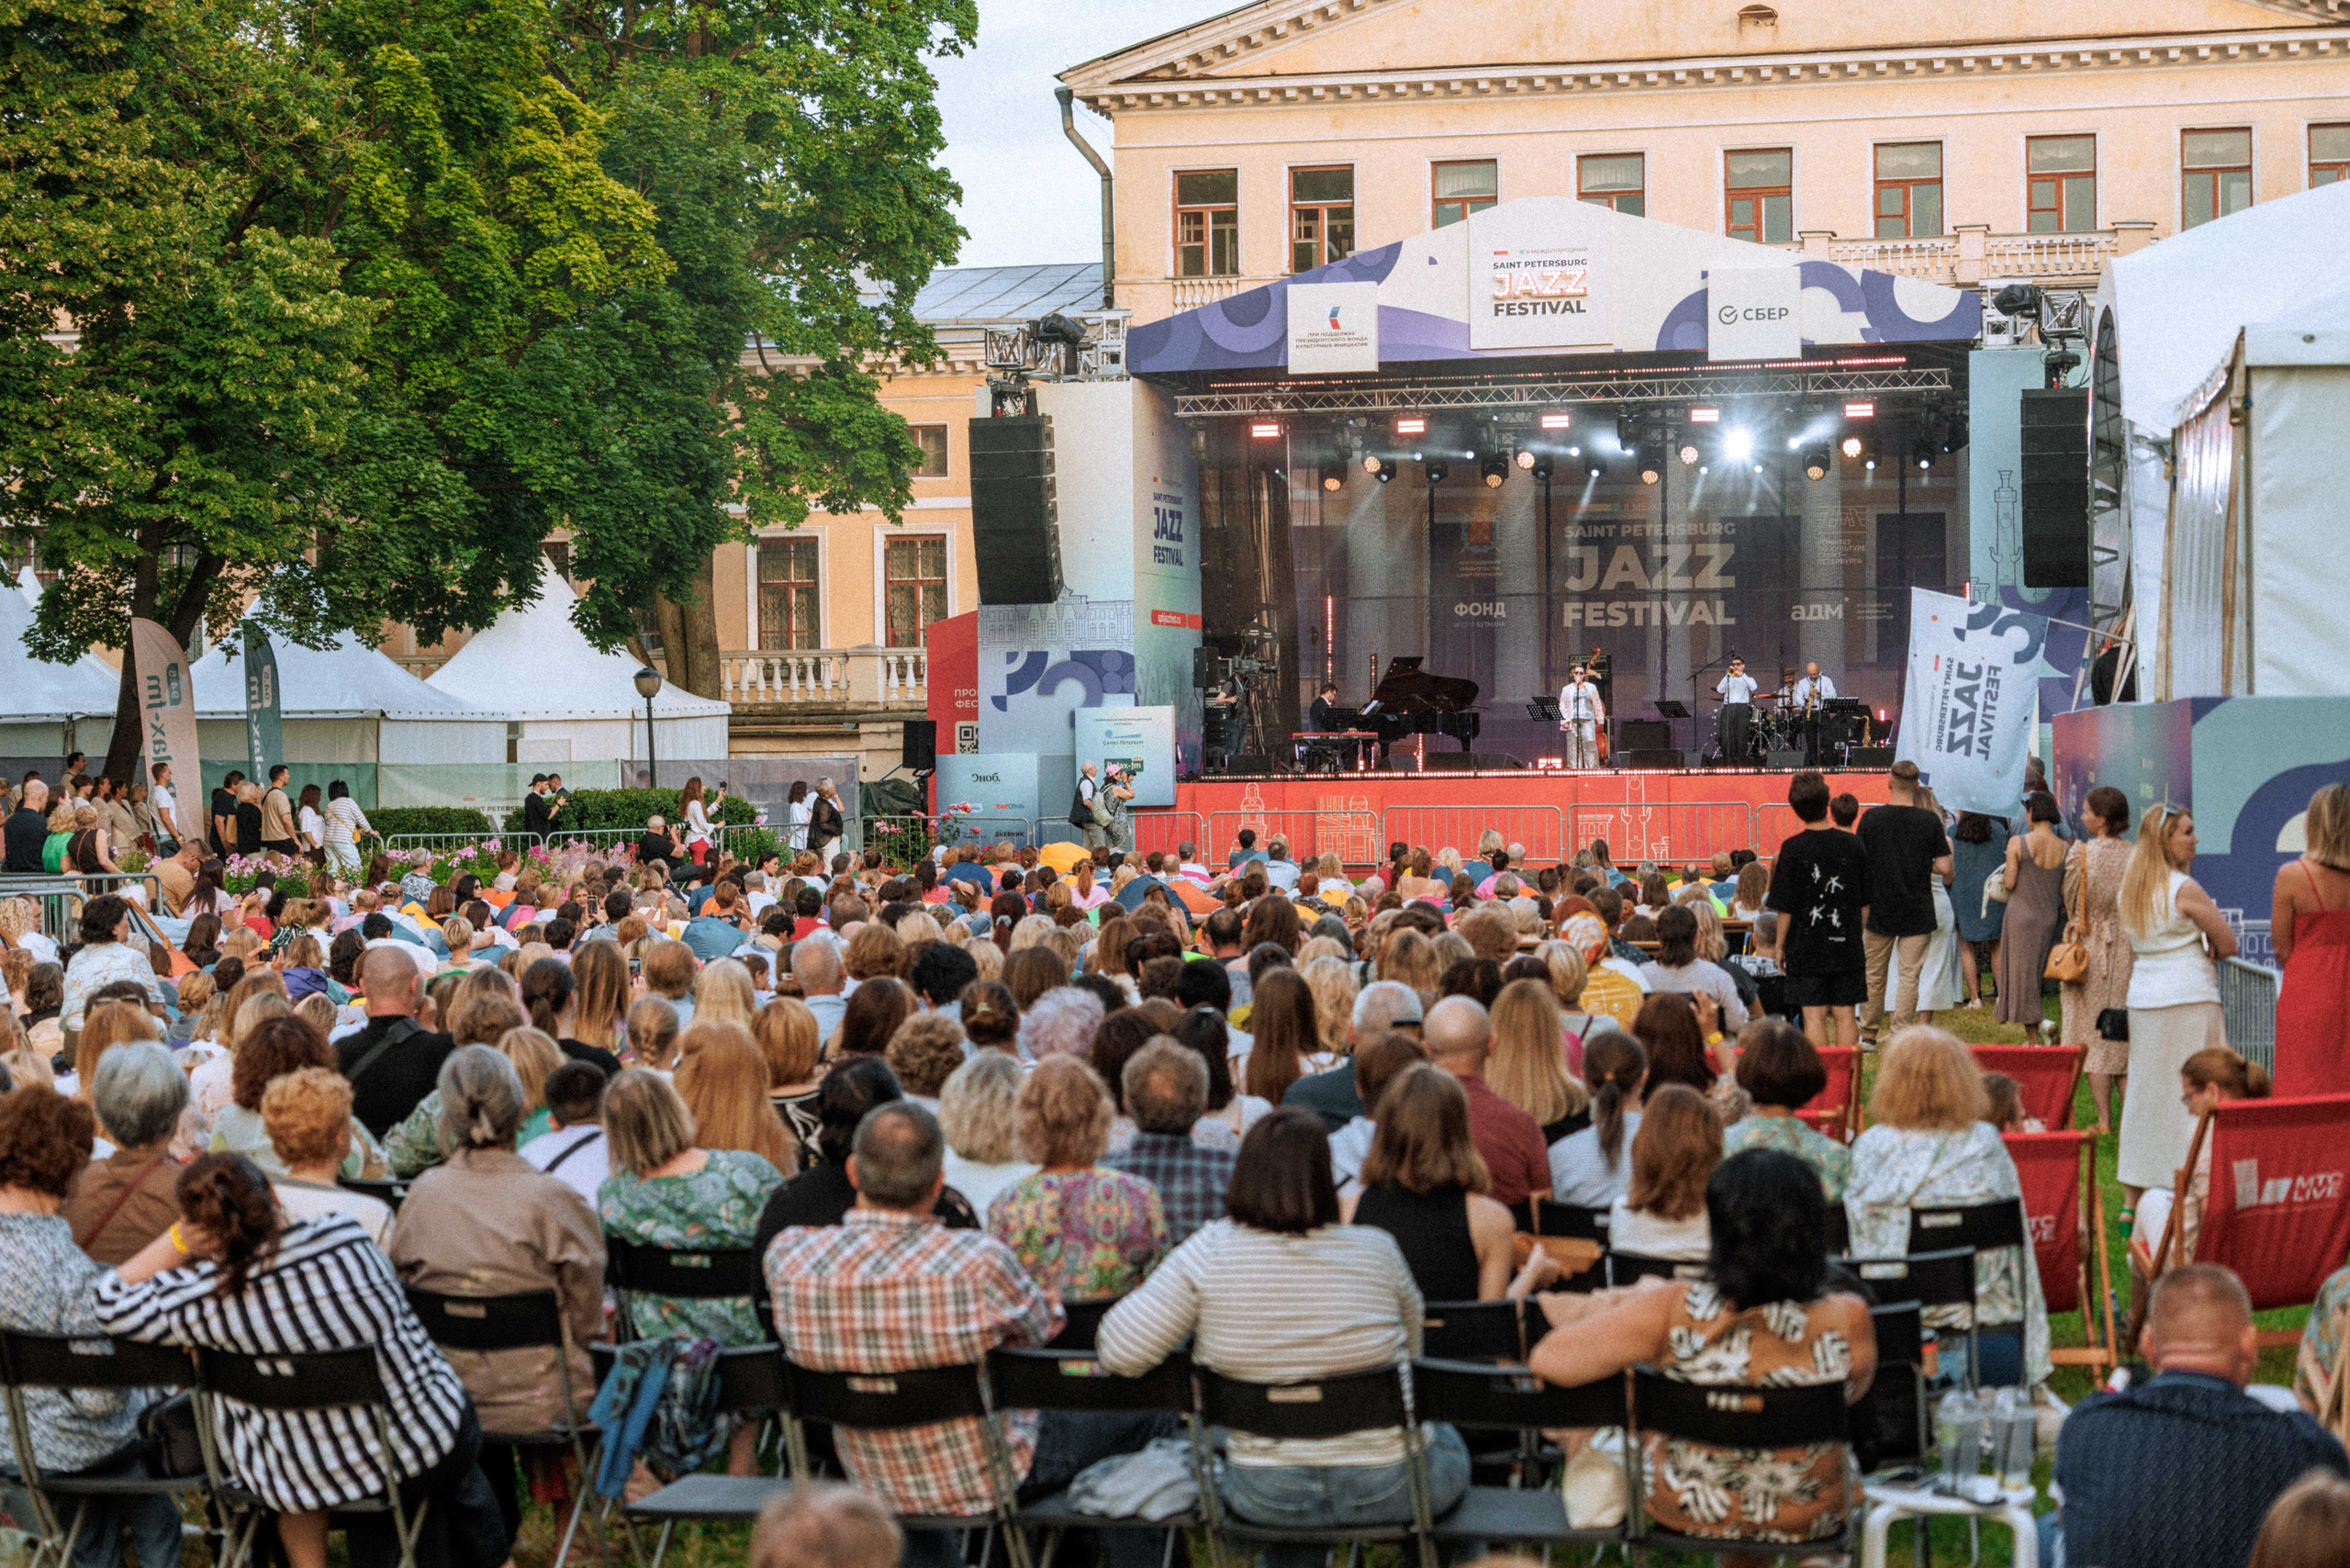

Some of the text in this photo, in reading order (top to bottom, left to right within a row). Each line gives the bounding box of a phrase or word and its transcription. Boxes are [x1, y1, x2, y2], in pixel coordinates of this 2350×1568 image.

[1493, 259, 1588, 270] SAINT PETERSBURG
[1494, 269, 1587, 298] JAZZ
[1494, 300, 1587, 317] FESTIVAL
[1742, 308, 1789, 321] СБЕР
[1153, 507, 1183, 543] JAZZ
[1564, 521, 1736, 539] SAINT PETERSBURG
[1153, 544, 1184, 567] FESTIVAL
[1564, 543, 1736, 592] JAZZ
[1454, 601, 1506, 618] ФОНД
[1563, 599, 1736, 628] FESTIVAL
